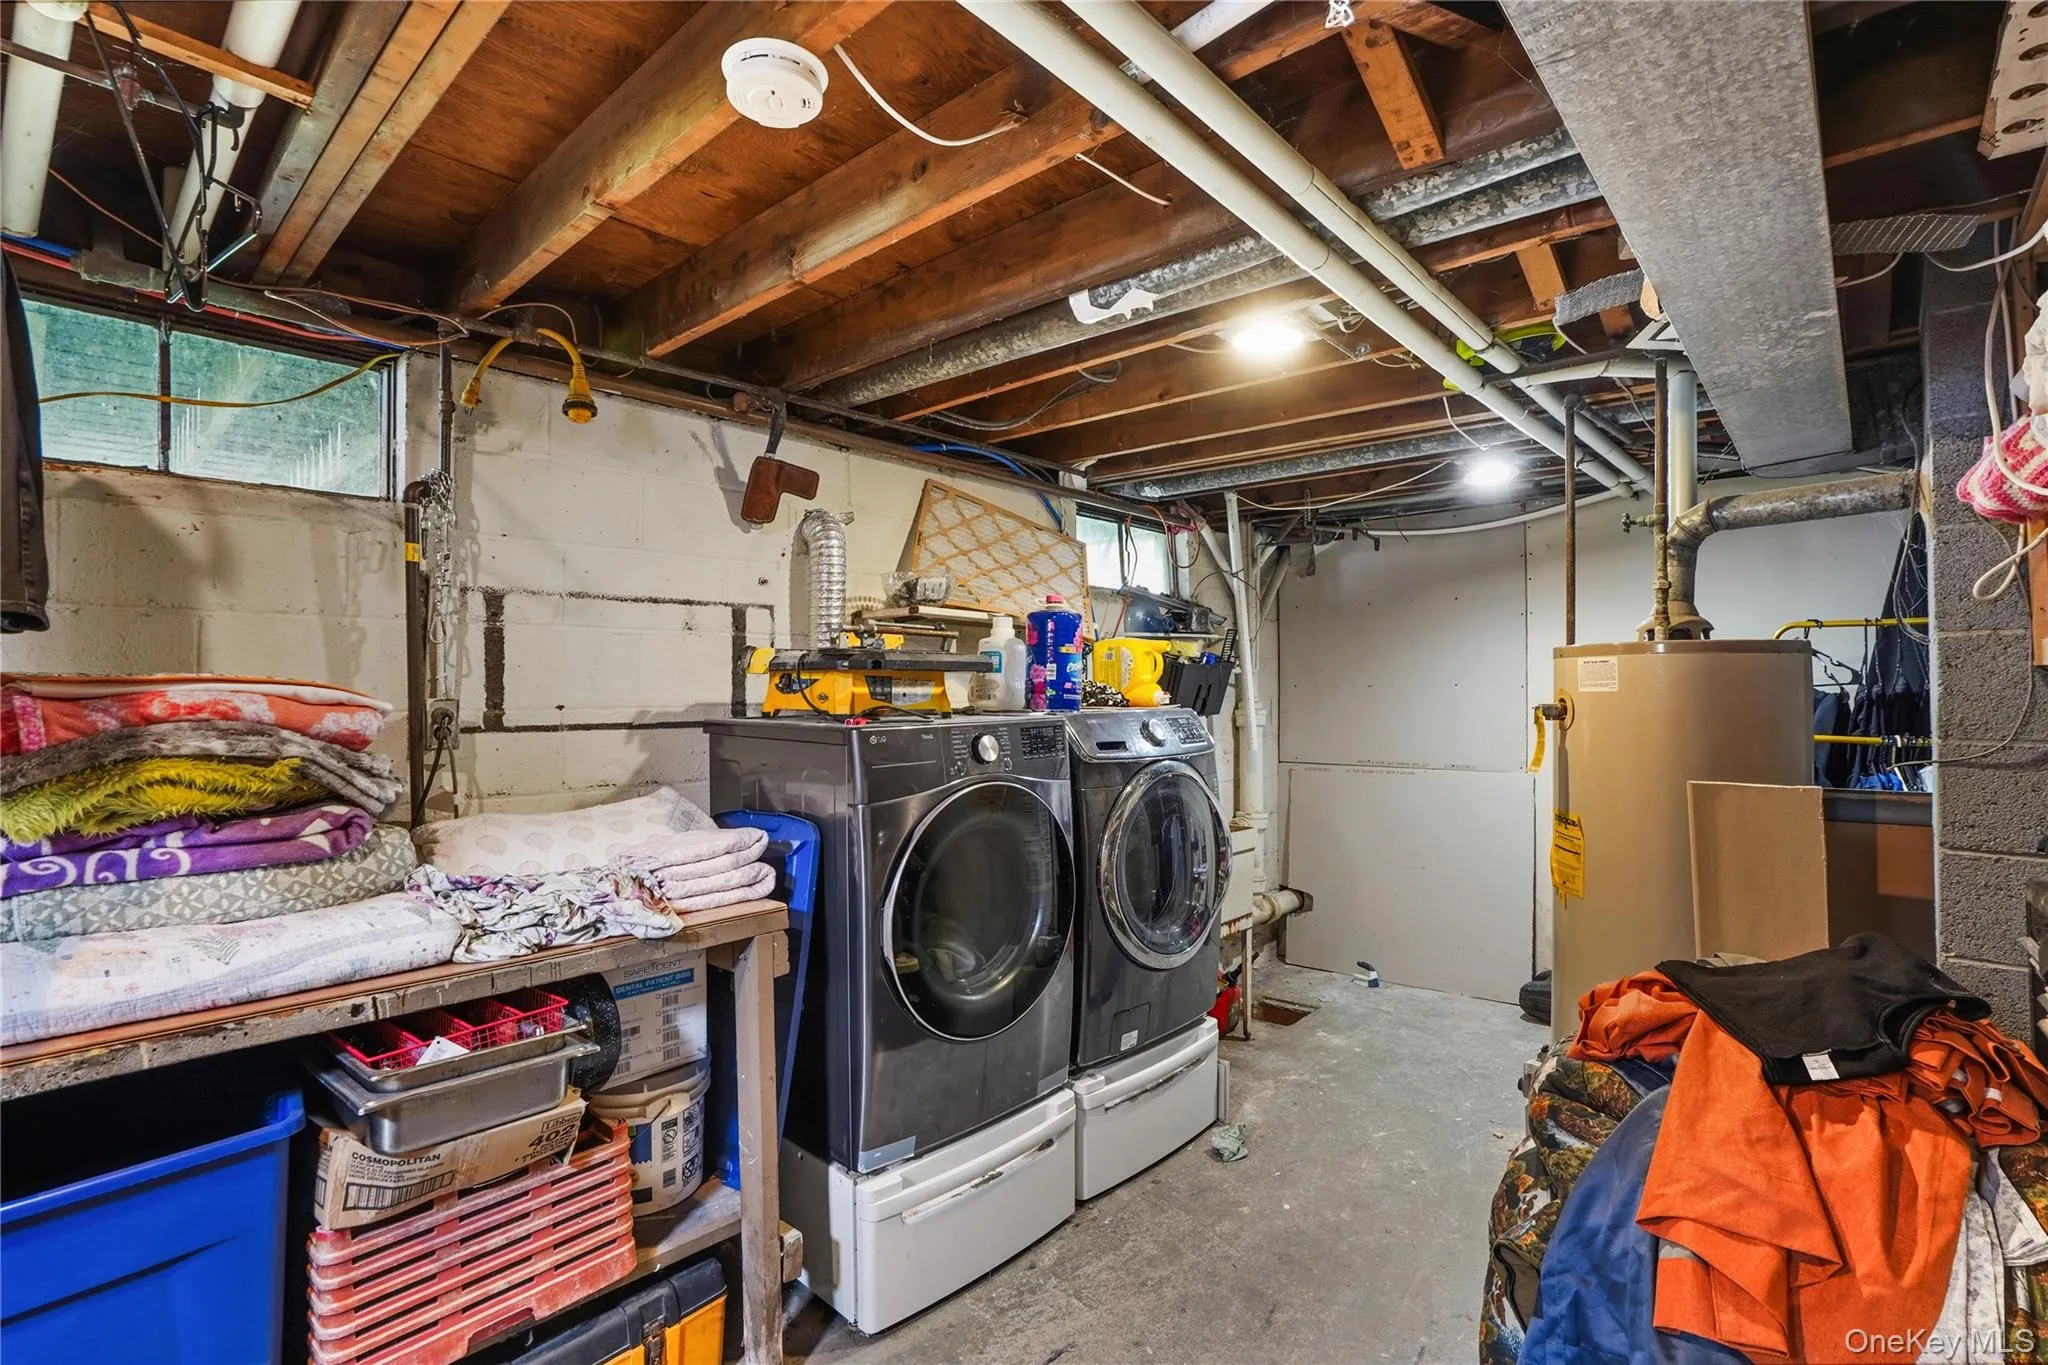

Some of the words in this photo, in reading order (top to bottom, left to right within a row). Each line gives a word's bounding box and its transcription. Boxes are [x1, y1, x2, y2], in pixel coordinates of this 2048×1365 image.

[615, 982, 645, 994] DENTAL
[645, 974, 674, 987] PATIENT
[528, 1123, 576, 1148] 402
[351, 1151, 441, 1167] COSMOPOLITAN
